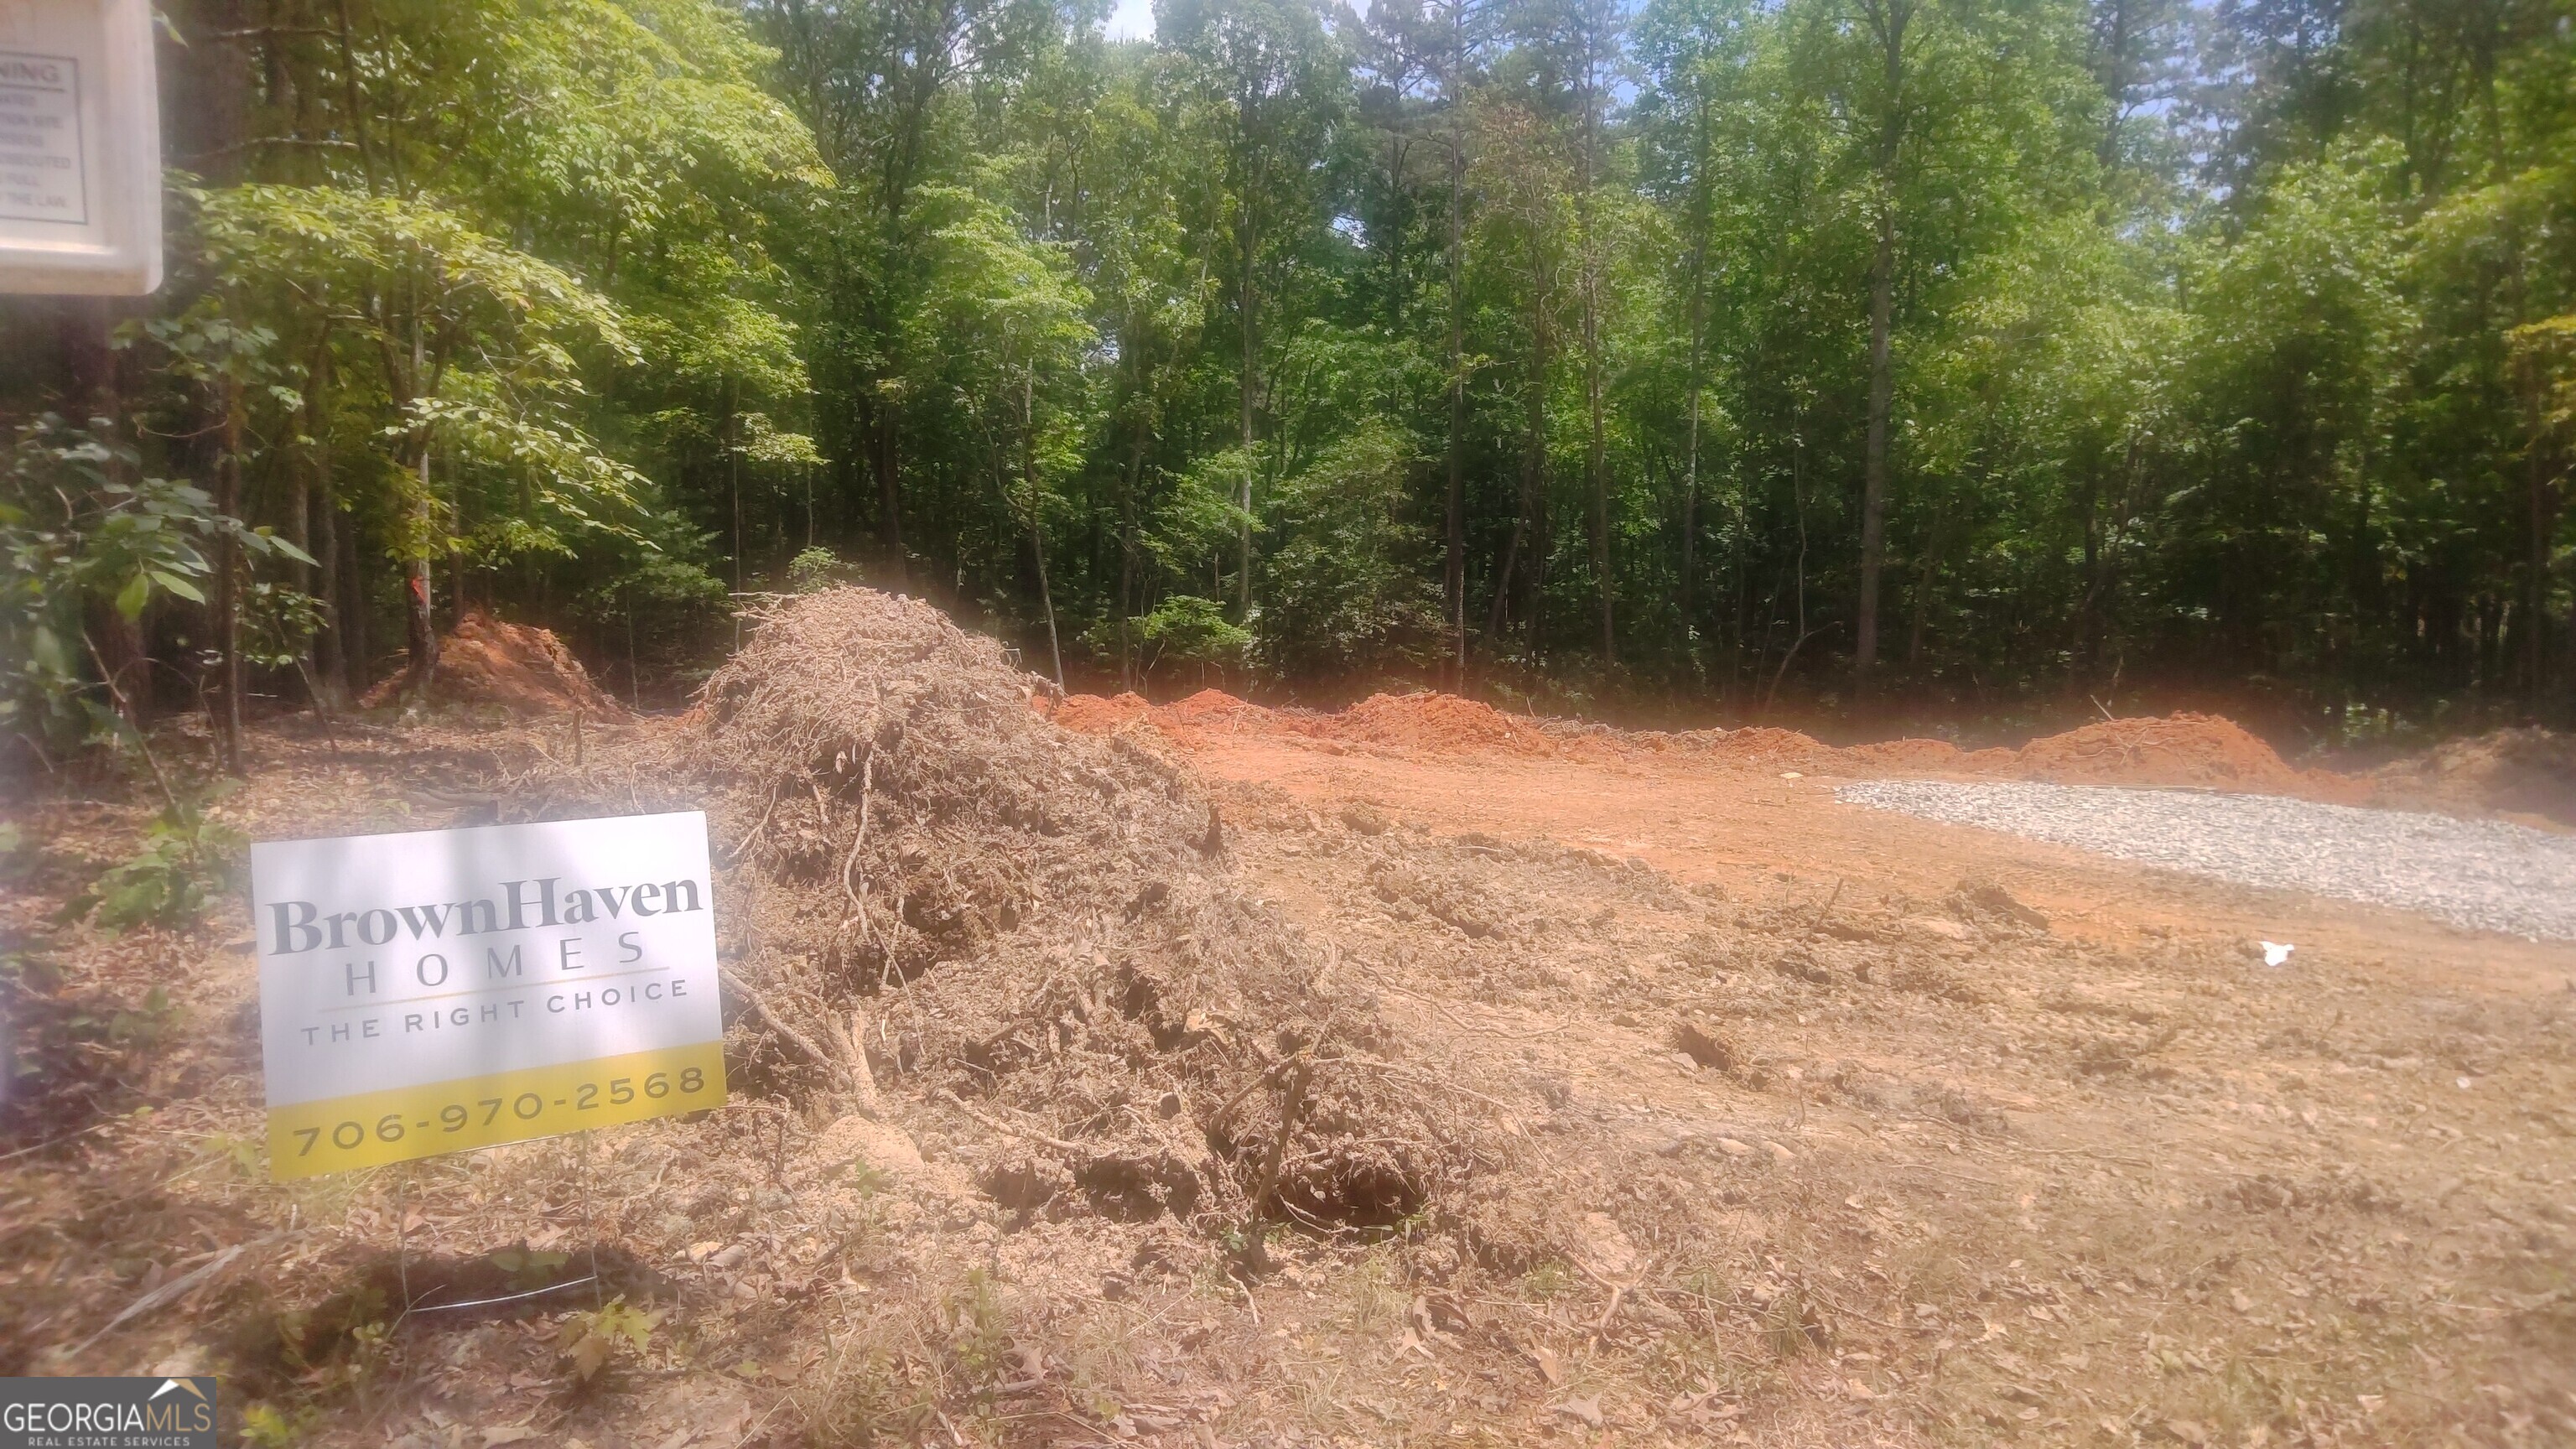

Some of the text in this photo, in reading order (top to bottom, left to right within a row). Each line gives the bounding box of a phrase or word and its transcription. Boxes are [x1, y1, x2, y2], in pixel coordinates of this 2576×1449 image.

[265, 877, 704, 956] BrownHaven
[345, 931, 643, 996] HOMES
[300, 979, 688, 1046] THE RIGHT CHOICE
[292, 1066, 705, 1158] 706-970-2568
